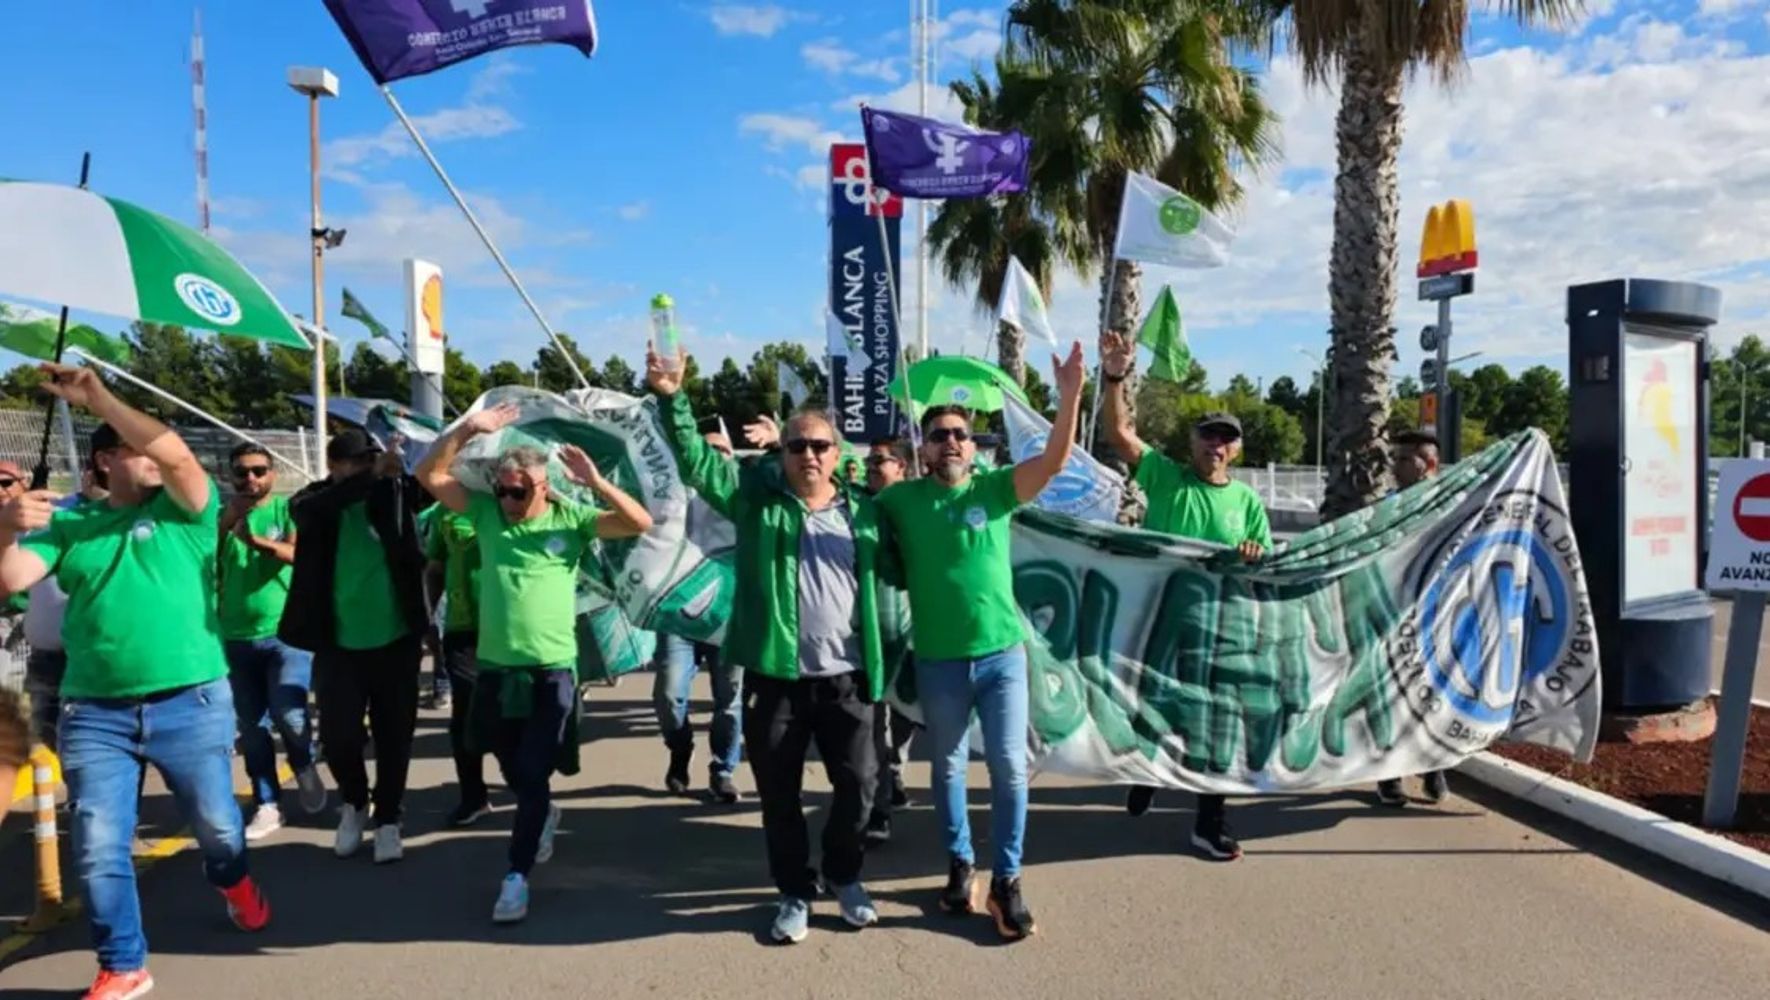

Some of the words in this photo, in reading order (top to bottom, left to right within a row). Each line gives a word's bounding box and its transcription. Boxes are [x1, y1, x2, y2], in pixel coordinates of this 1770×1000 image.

[873, 271, 890, 360] SHOPPING
[844, 370, 865, 433] BAHI
[874, 362, 889, 416] PLAZA
